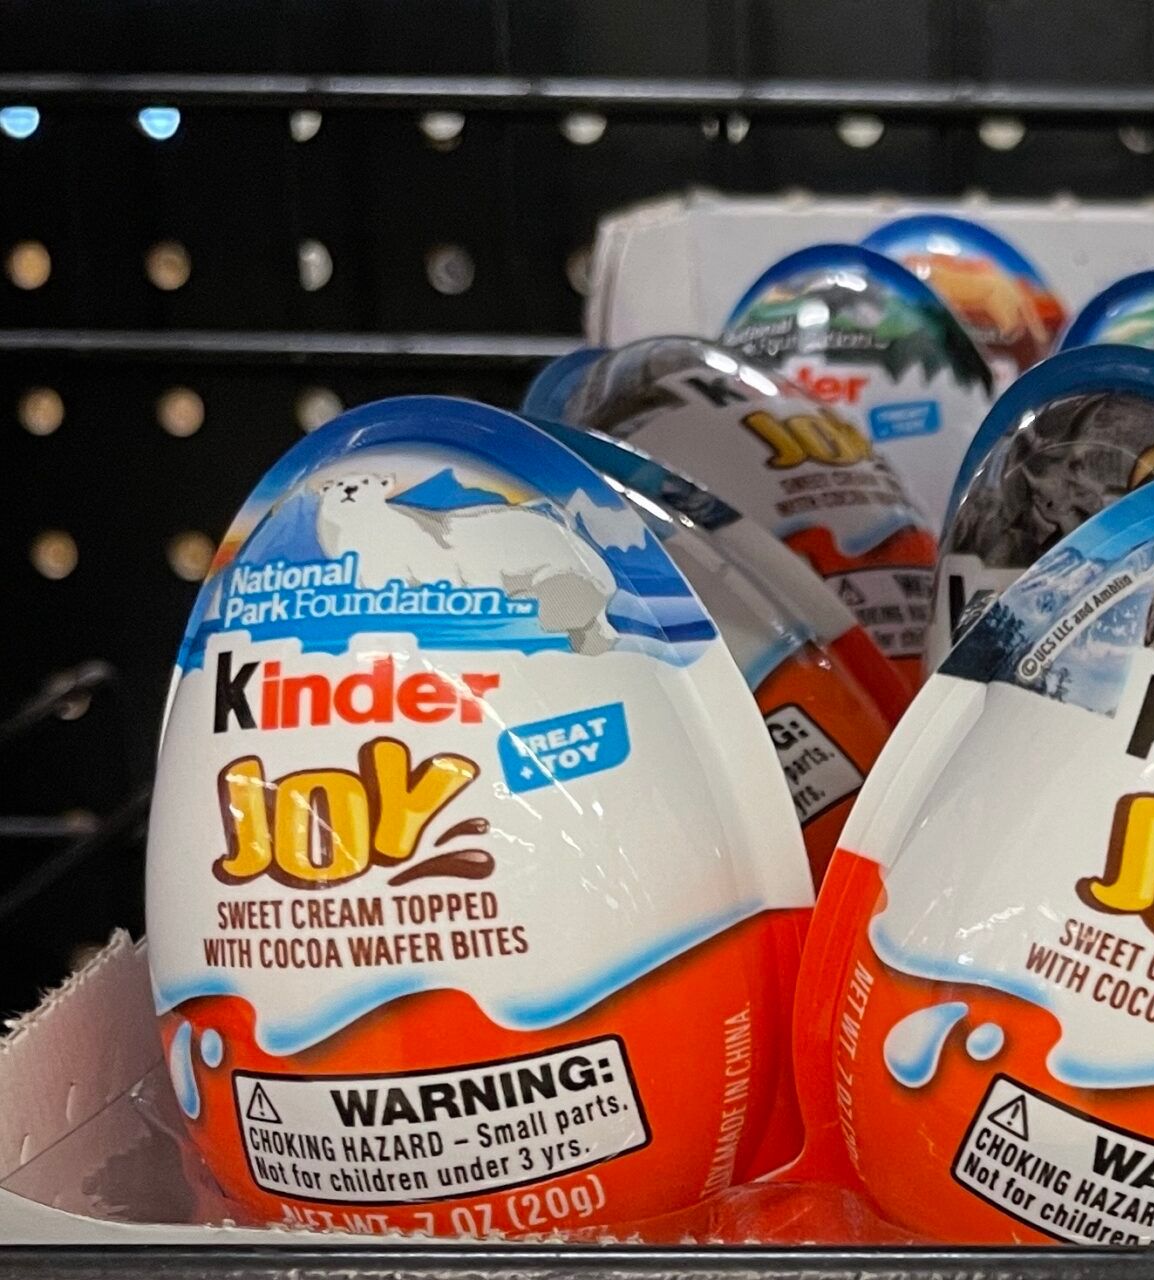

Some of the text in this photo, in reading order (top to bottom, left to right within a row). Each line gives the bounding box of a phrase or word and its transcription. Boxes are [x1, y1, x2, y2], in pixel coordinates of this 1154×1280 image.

[230, 554, 356, 596] National
[225, 598, 289, 628] Park
[517, 717, 609, 756] TREAT
[544, 742, 602, 777] TOY
[212, 737, 480, 889] JOY
[217, 891, 500, 931] SWEET CREAM TOPPED
[203, 925, 530, 969] WITH COCOA WAFER BITES
[1025, 942, 1088, 988] WITH
[1058, 918, 1139, 973] SWEET
[846, 959, 875, 1020] NET
[724, 1001, 751, 1077] CHINA.
[329, 1054, 615, 1129] WARNING:
[248, 1094, 629, 1164] CHOKING HAZARD Small parts.
[254, 1137, 592, 1196] Not for children under 3 yrs.
[963, 1156, 999, 1193] Not
[1002, 1177, 1037, 1210] for
[974, 1126, 1072, 1195] CHOKING
[506, 1174, 606, 1232] (20g)
